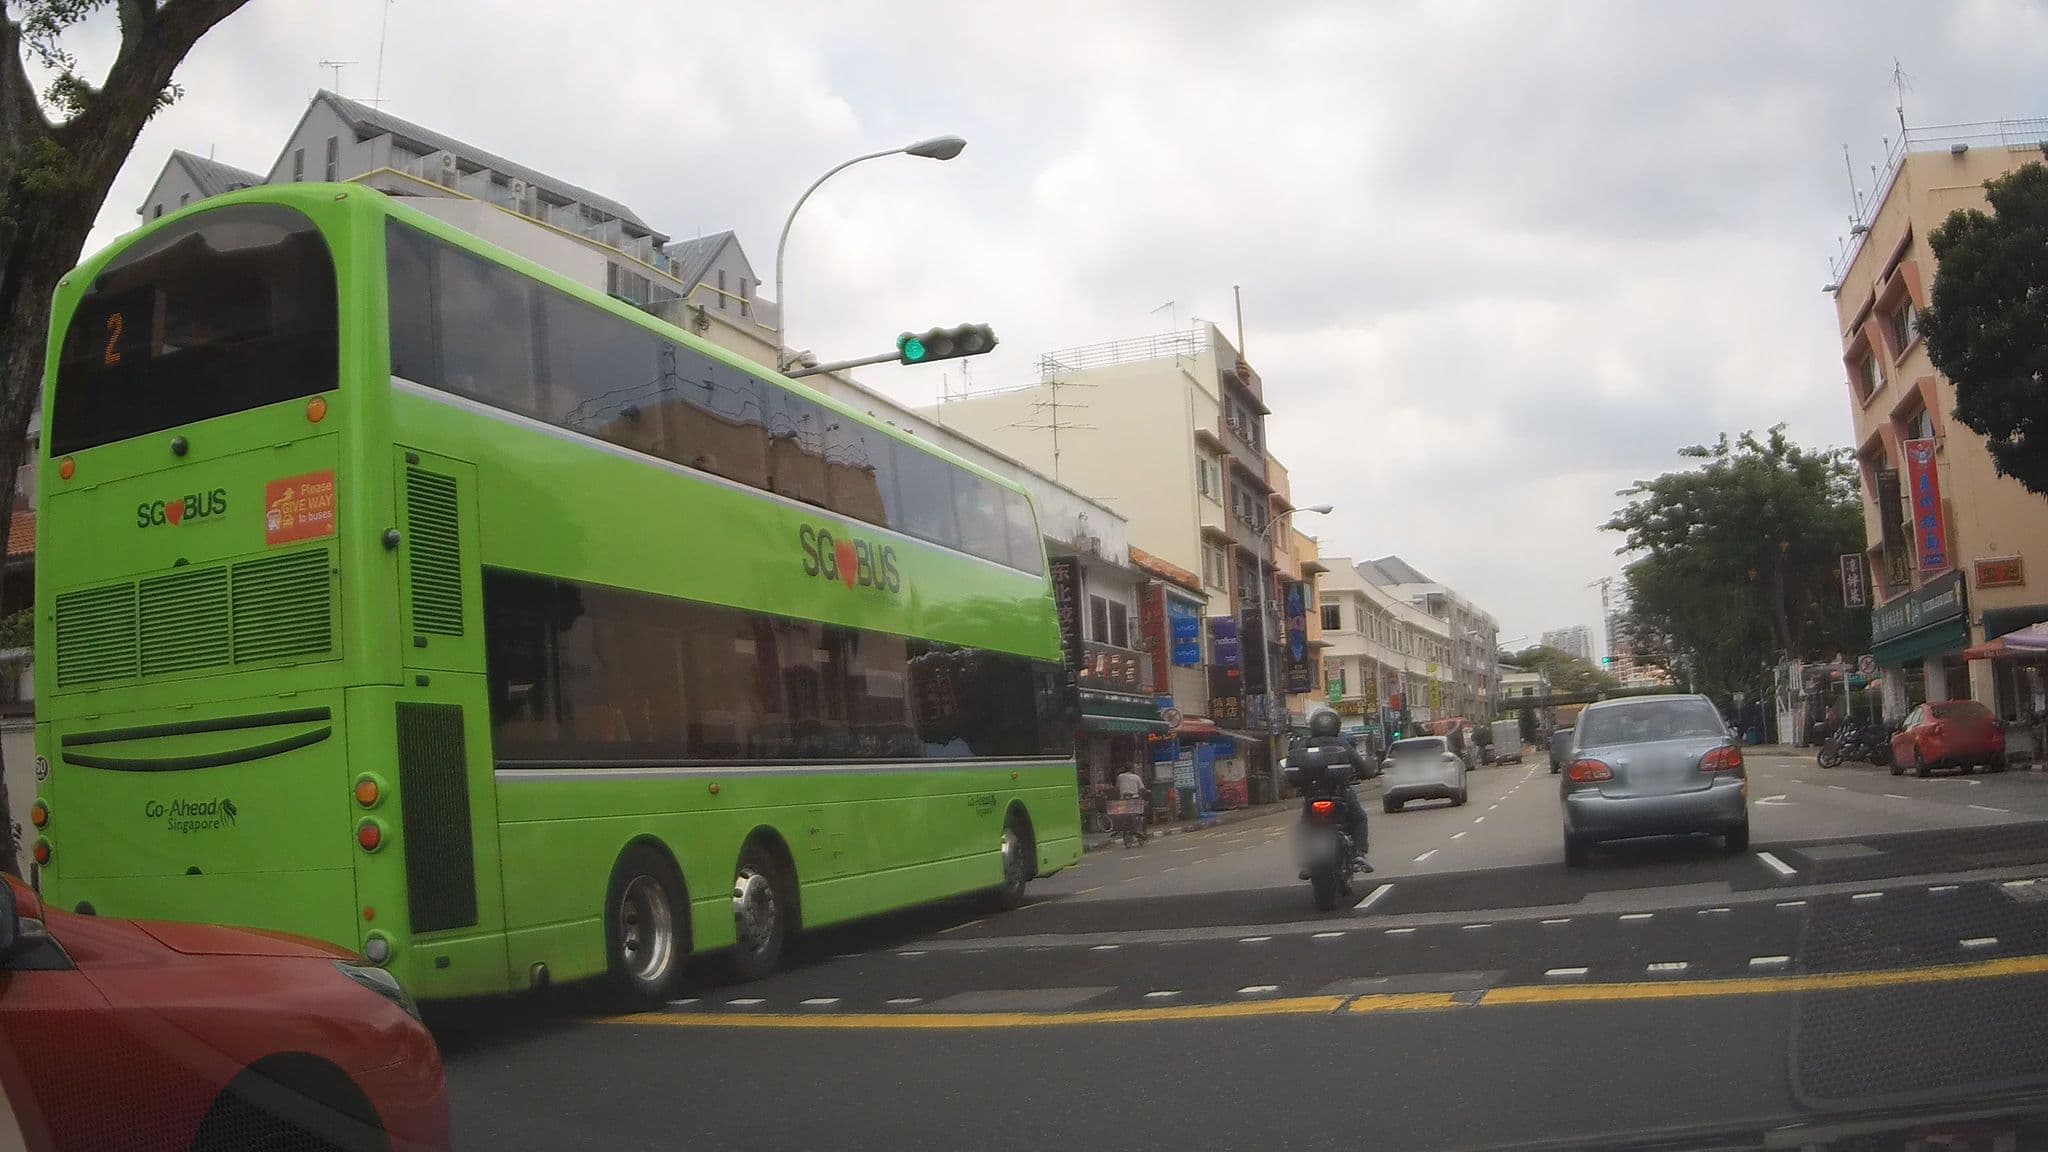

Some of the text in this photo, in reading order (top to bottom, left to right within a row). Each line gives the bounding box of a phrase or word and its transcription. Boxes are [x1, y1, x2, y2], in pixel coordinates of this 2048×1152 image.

[104, 312, 124, 365] 2
[301, 482, 332, 495] Please
[282, 494, 332, 514] GIVE WAY
[308, 510, 332, 521] buses
[145, 797, 217, 818] Go-Ahead
[167, 817, 220, 834] Singapore
